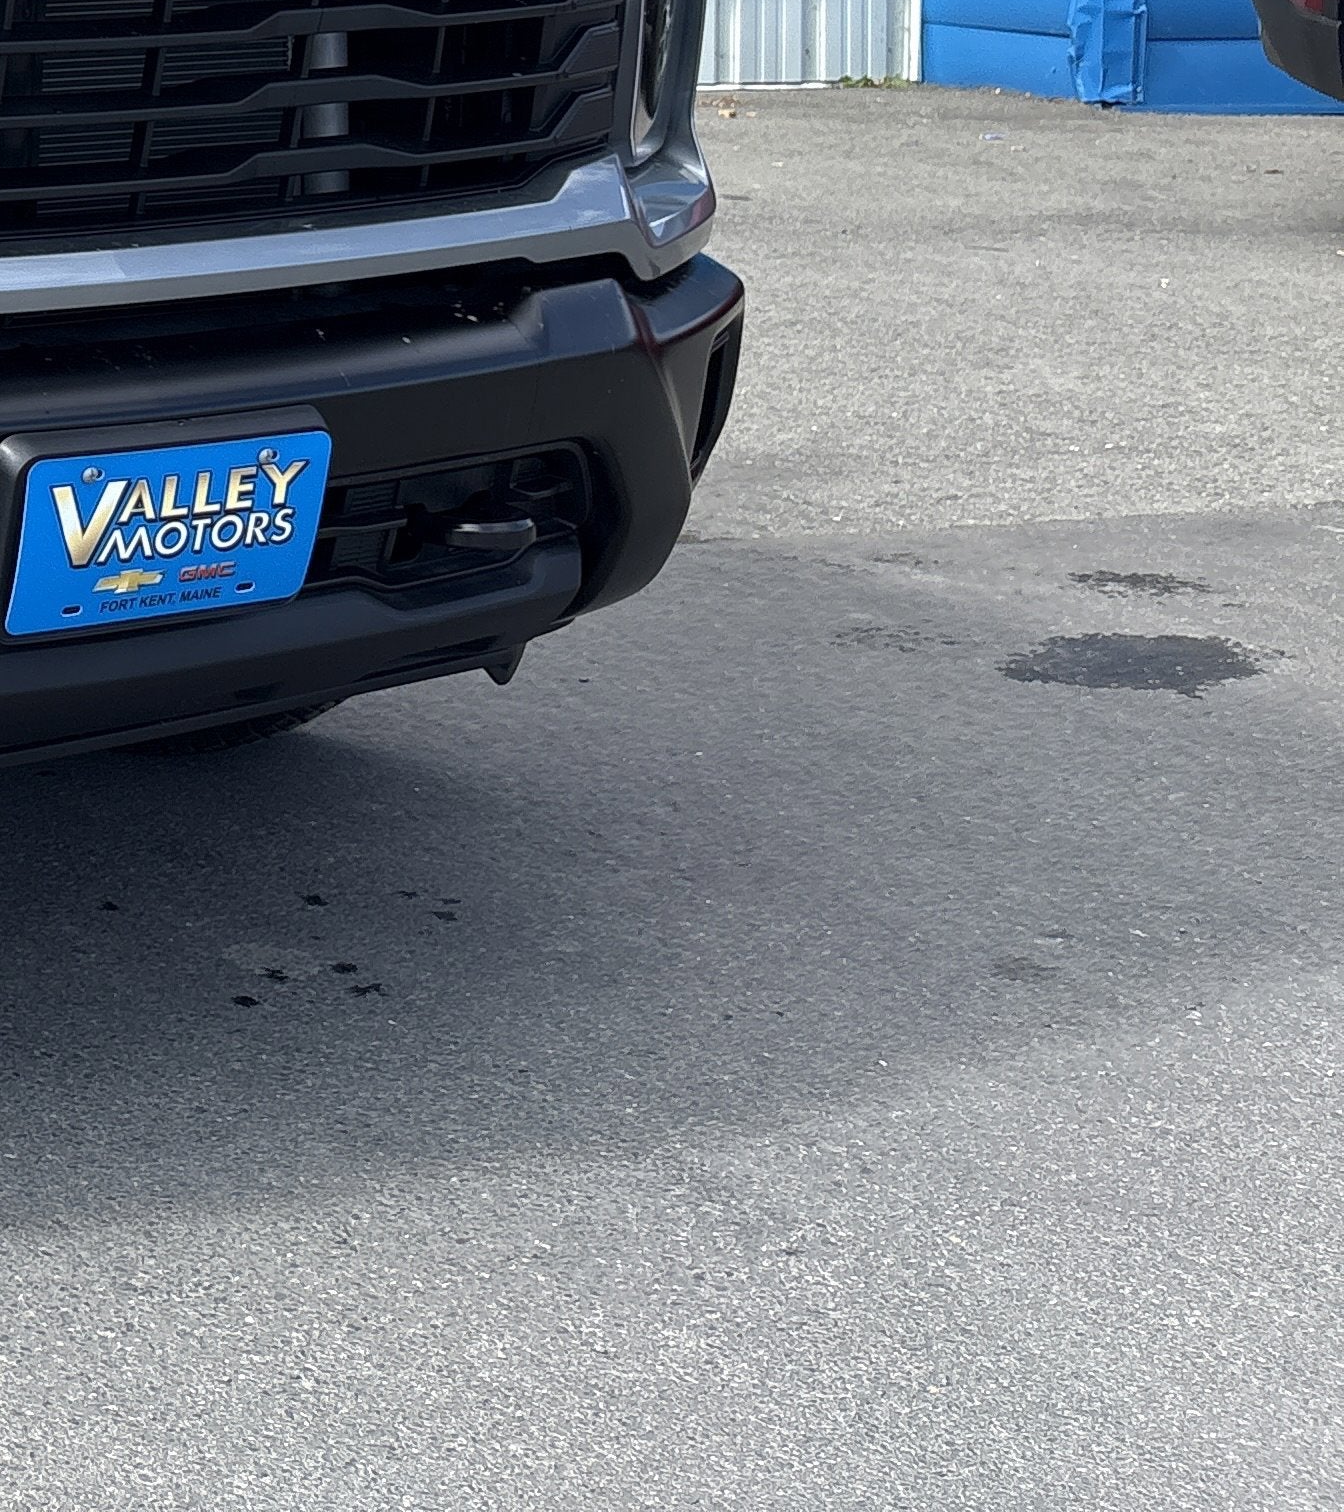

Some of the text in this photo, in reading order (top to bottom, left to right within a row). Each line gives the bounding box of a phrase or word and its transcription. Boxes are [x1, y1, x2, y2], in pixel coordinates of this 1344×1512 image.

[52, 460, 309, 568] VALLEY
[96, 507, 295, 563] MOTORS
[178, 561, 237, 582] GMC
[99, 597, 136, 614] FORT
[178, 586, 222, 603] MAINE
